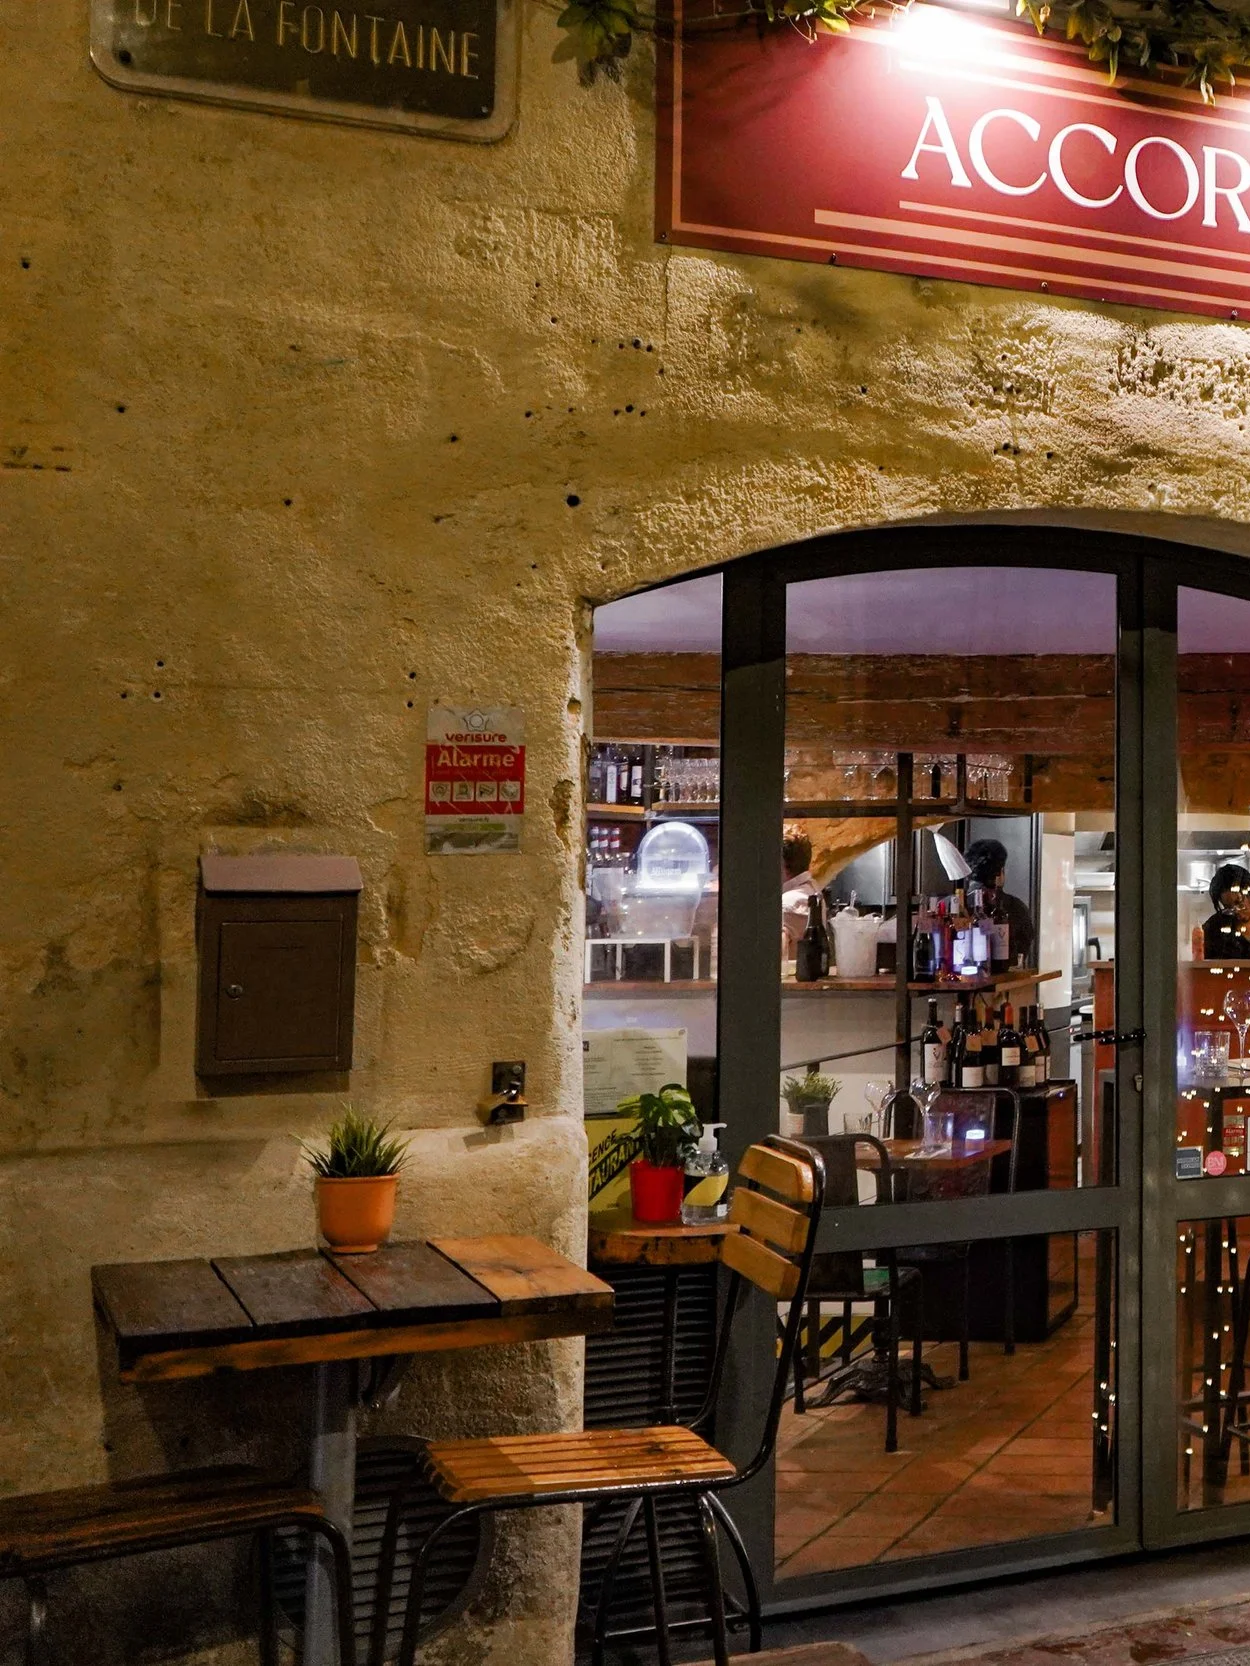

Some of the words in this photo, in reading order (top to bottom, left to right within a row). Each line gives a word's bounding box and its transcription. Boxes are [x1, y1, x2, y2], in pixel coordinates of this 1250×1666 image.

[207, 0, 254, 42] LA
[277, 0, 481, 80] FONTAINE
[445, 732, 507, 743] verisure
[436, 749, 516, 767] Alarme
